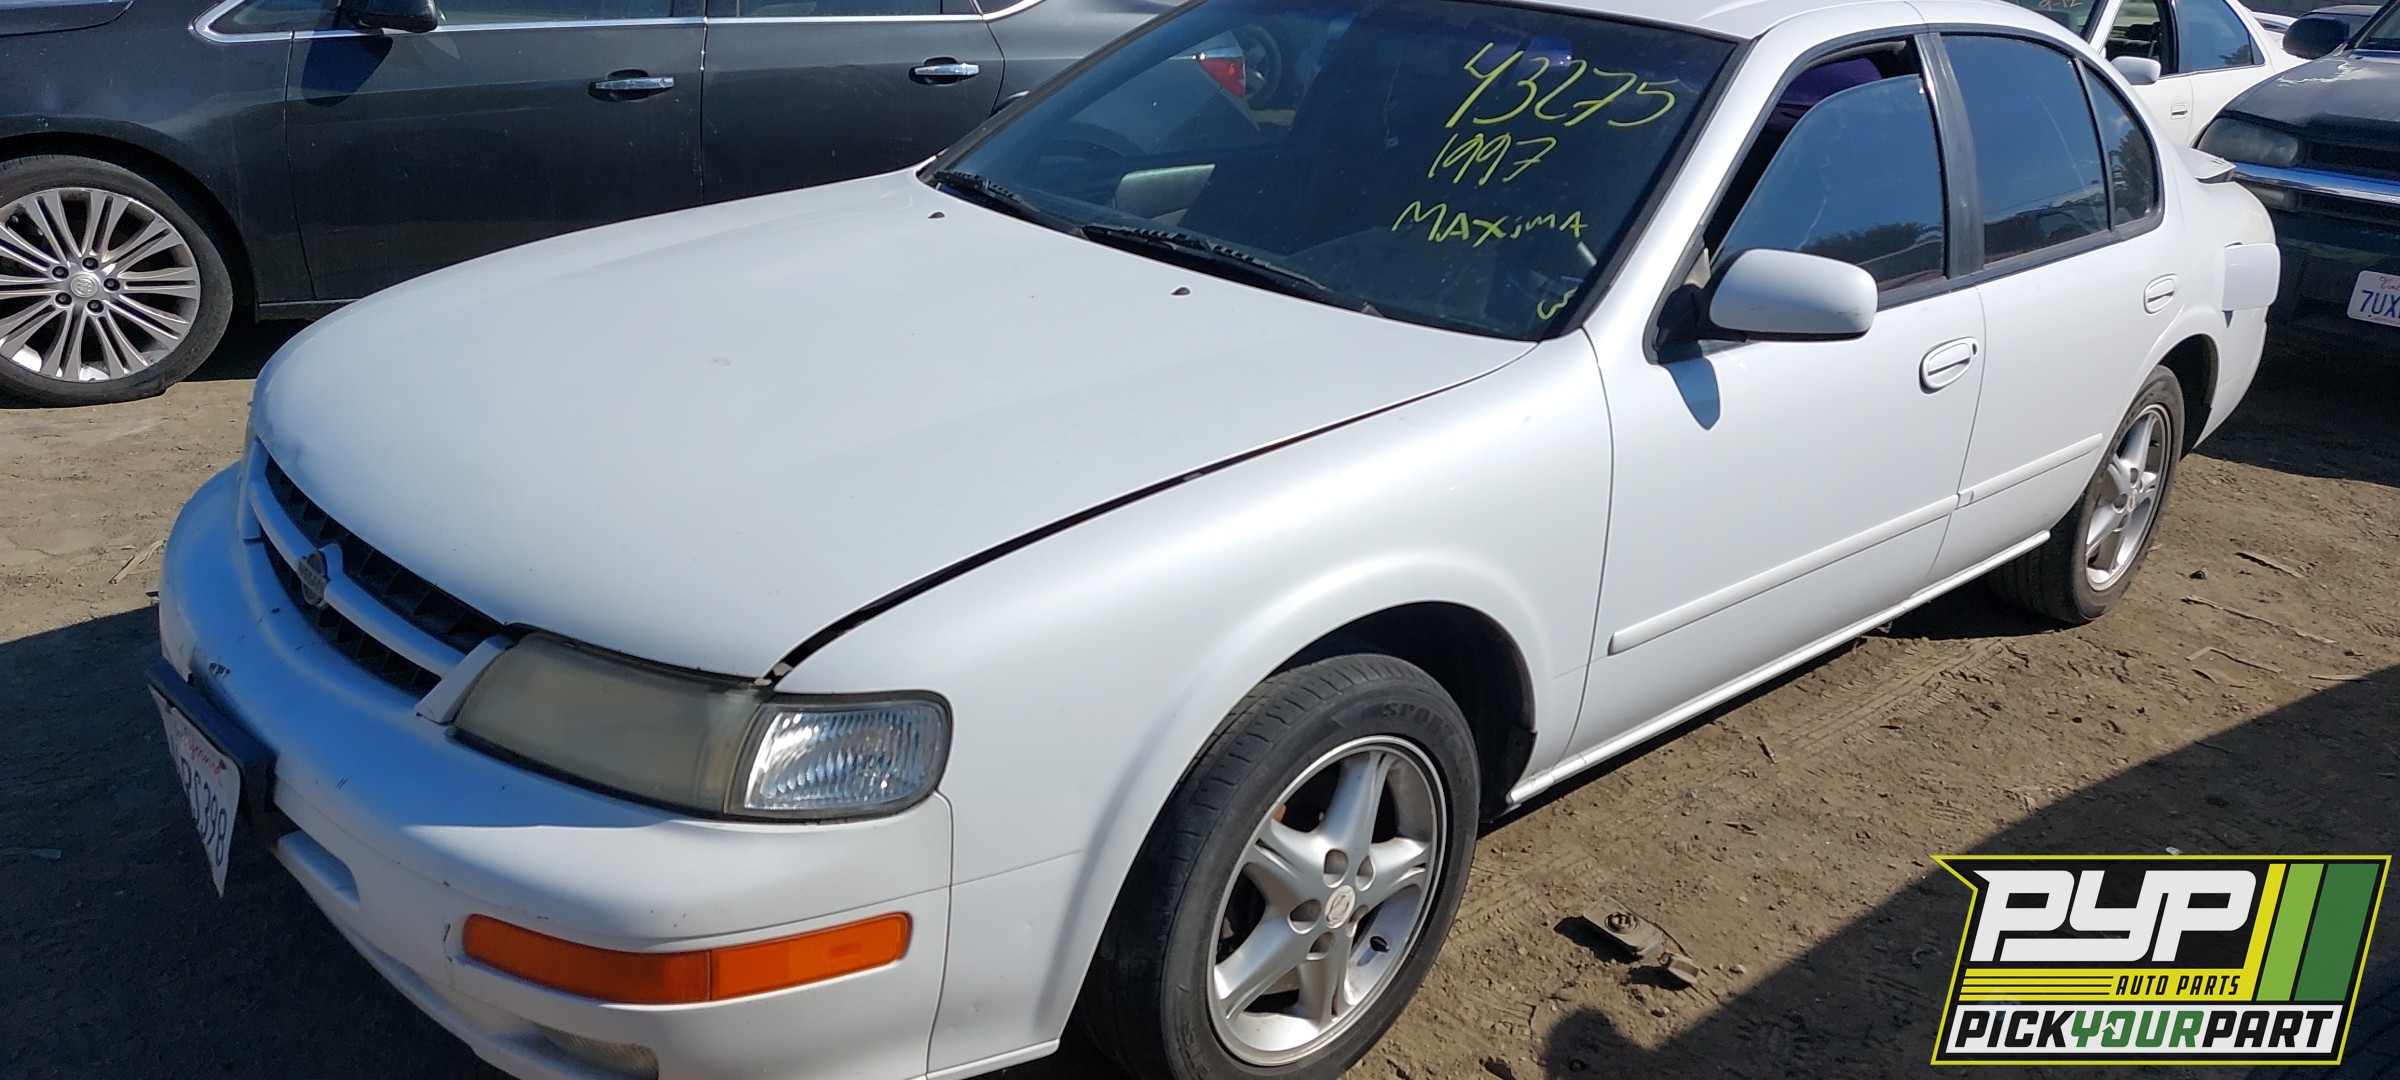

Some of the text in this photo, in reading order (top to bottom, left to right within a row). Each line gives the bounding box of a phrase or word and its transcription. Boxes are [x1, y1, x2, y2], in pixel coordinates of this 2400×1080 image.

[1445, 42, 1680, 127] 43275
[1427, 131, 1557, 186] 1997
[2360, 289, 2400, 319] 7UX
